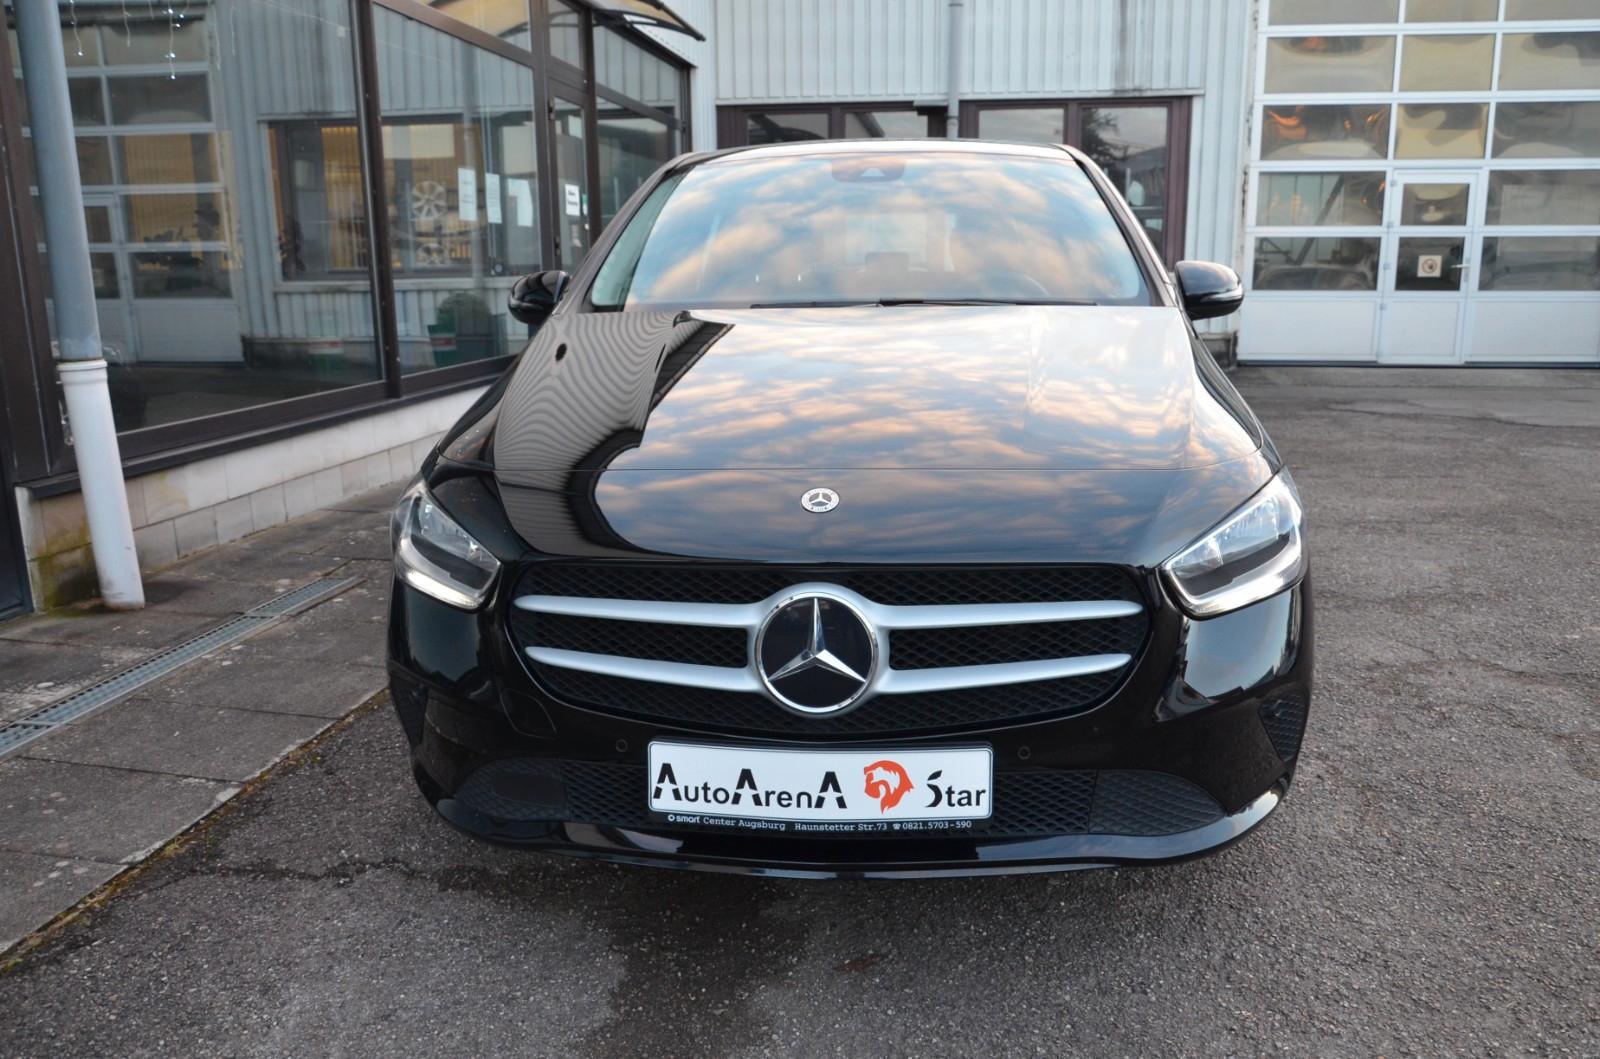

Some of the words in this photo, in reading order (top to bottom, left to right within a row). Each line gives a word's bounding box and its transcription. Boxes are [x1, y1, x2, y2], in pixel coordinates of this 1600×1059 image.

[925, 769, 986, 808] Star
[676, 814, 700, 824] smart
[703, 816, 736, 826] Center
[738, 819, 785, 831] Augsburg
[795, 822, 854, 832] Haunstetter
[857, 823, 888, 831] Str.73
